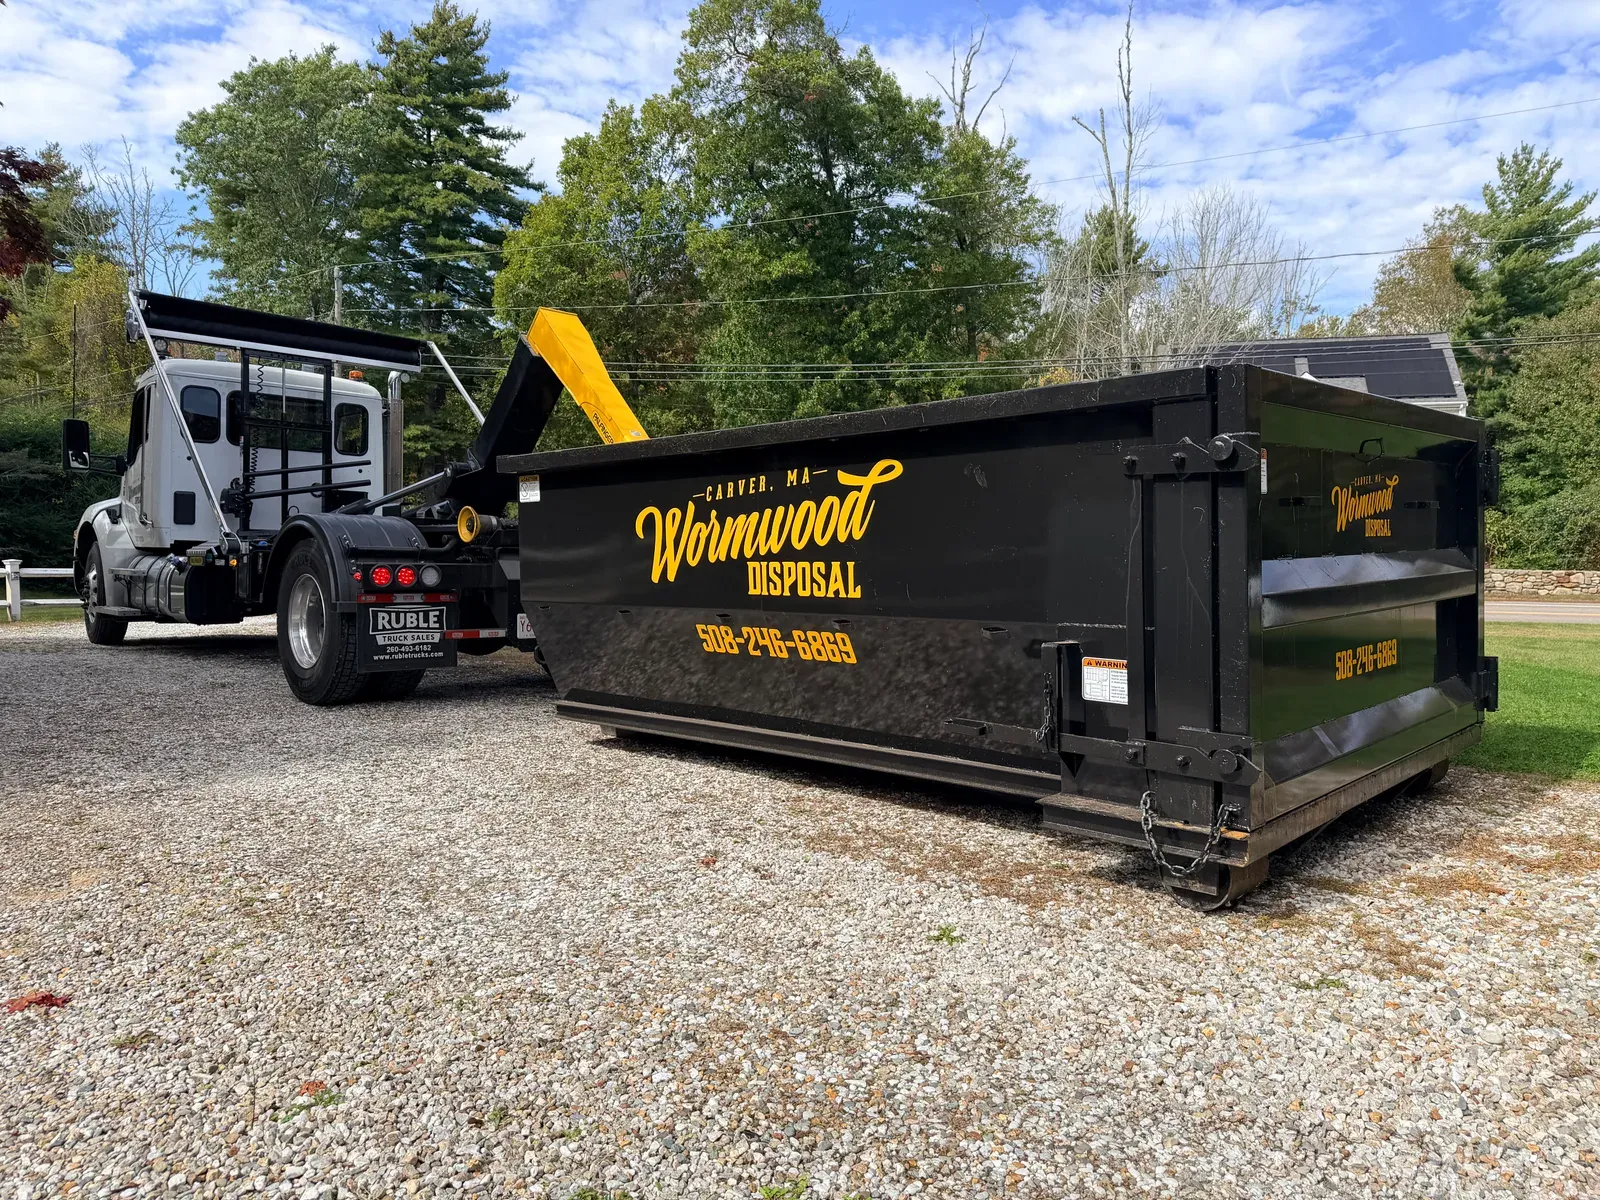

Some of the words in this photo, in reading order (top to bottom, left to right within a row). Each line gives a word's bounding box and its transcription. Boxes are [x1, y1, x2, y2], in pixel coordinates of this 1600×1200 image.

[706, 475, 774, 502] CARVER,
[786, 467, 810, 487] MA
[1331, 474, 1399, 533] Wormwood
[635, 458, 904, 584] Wormwood
[1365, 518, 1391, 537] DISPOSAL
[747, 561, 862, 598] DISPOSAL
[377, 611, 440, 630] RUBLE
[386, 644, 432, 653] 260-493-6182
[411, 633, 435, 641] SALES
[695, 624, 857, 664] 508-246-6869
[373, 651, 444, 661] www.rubletrucks.com
[1095, 660, 1128, 669] WARNIN
[1335, 638, 1397, 681] 508-246-6869
